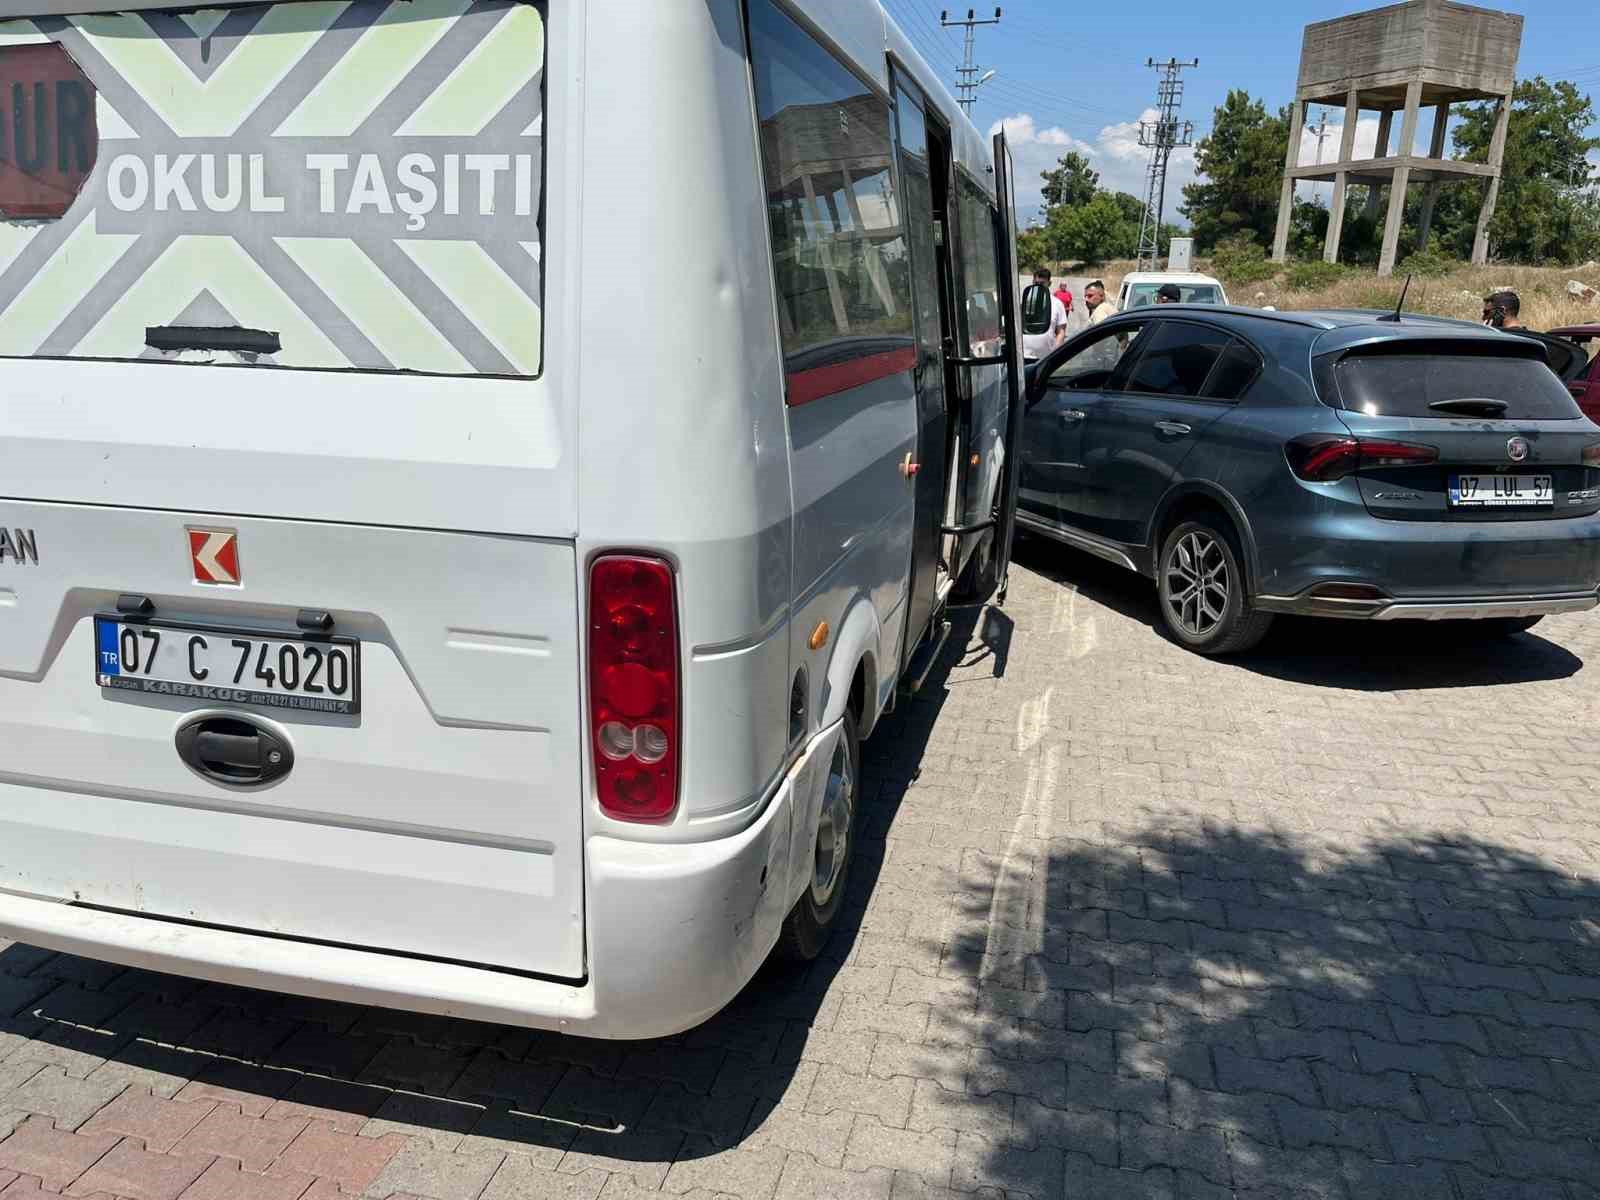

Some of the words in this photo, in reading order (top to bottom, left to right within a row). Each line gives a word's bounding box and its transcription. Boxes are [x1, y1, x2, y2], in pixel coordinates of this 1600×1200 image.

[0, 80, 91, 174] UR
[106, 153, 286, 213] OKUL
[305, 152, 532, 232] TAŞITI
[1460, 477, 1479, 497] 07
[1494, 477, 1522, 497] LUL
[1534, 477, 1551, 497] 57
[102, 651, 118, 664] TR
[120, 628, 160, 674] 07
[187, 635, 209, 681] C
[231, 640, 348, 695] 74020
